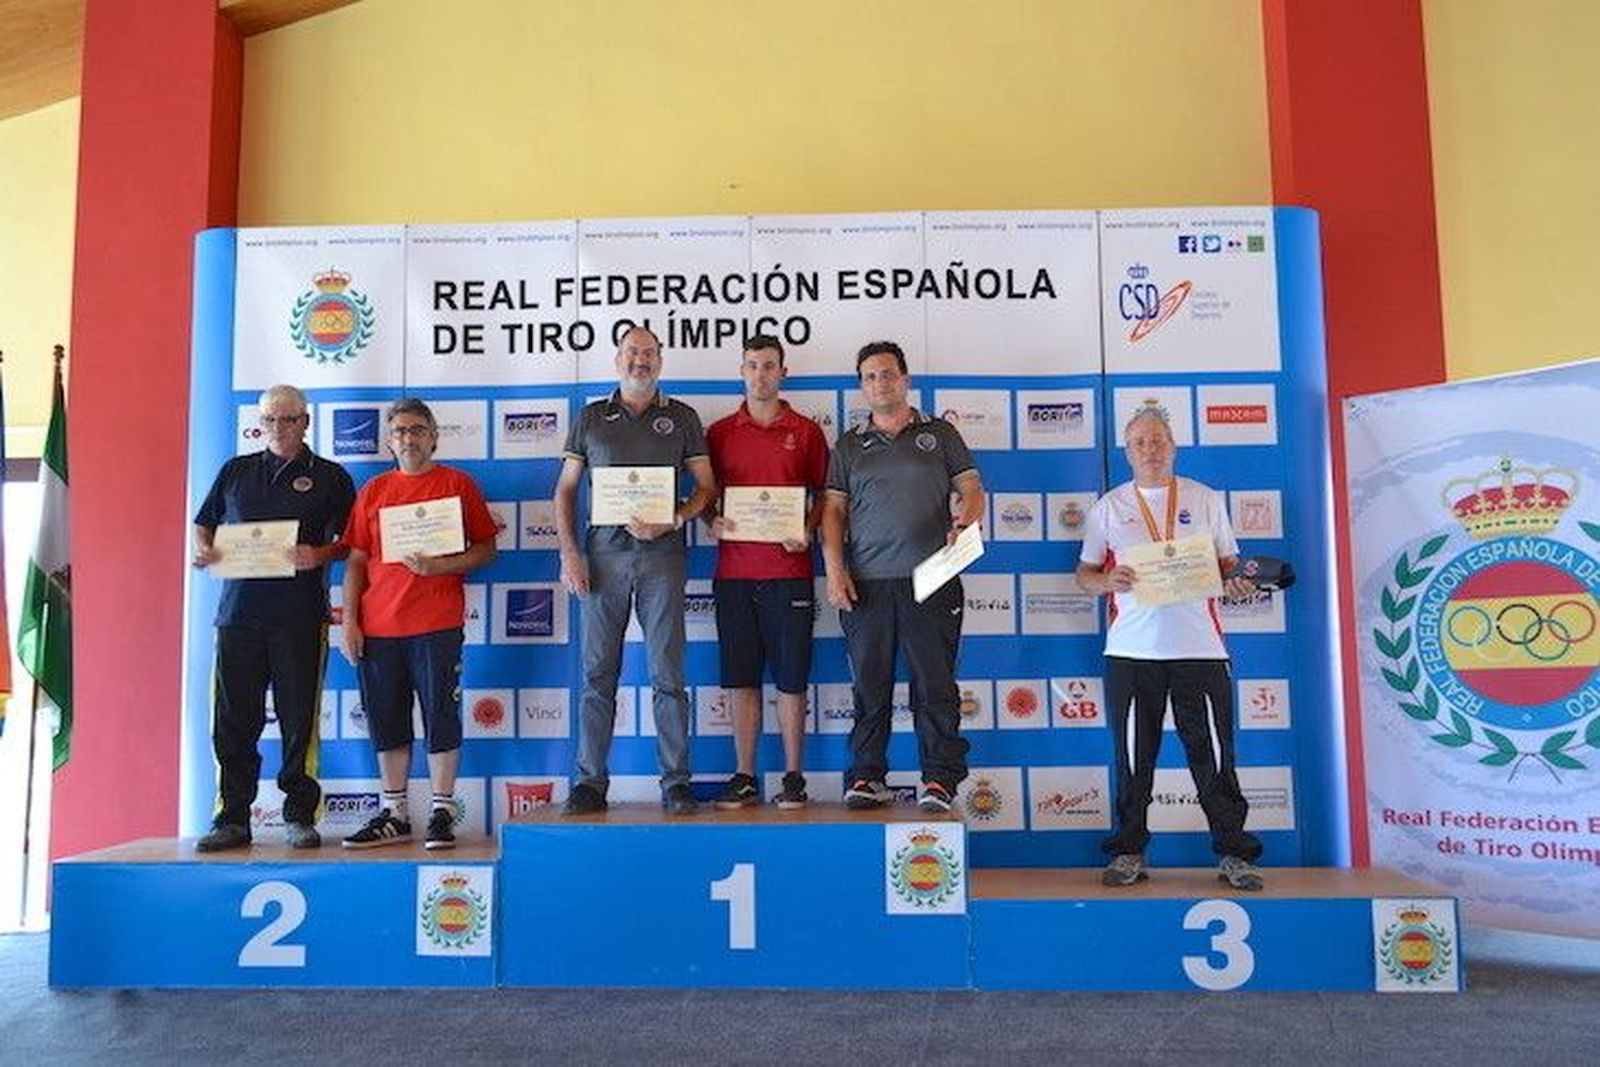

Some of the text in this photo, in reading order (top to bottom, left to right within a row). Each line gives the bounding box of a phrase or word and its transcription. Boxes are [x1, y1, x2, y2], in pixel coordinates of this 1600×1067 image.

[433, 260, 1058, 310] REAL FEDERACIÓN ESPAÑOLA
[1119, 283, 1160, 320] CSD
[433, 324, 485, 354] DE
[501, 321, 595, 353] TIRO
[526, 706, 561, 719] Vinci
[1060, 702, 1097, 719] GB
[1382, 808, 1431, 826] Real
[1440, 811, 1579, 834] Federación
[1437, 836, 1466, 855] de
[1475, 838, 1523, 858] Tiro
[710, 863, 756, 950] 1
[238, 881, 307, 968] 2
[1182, 899, 1255, 991] 3
